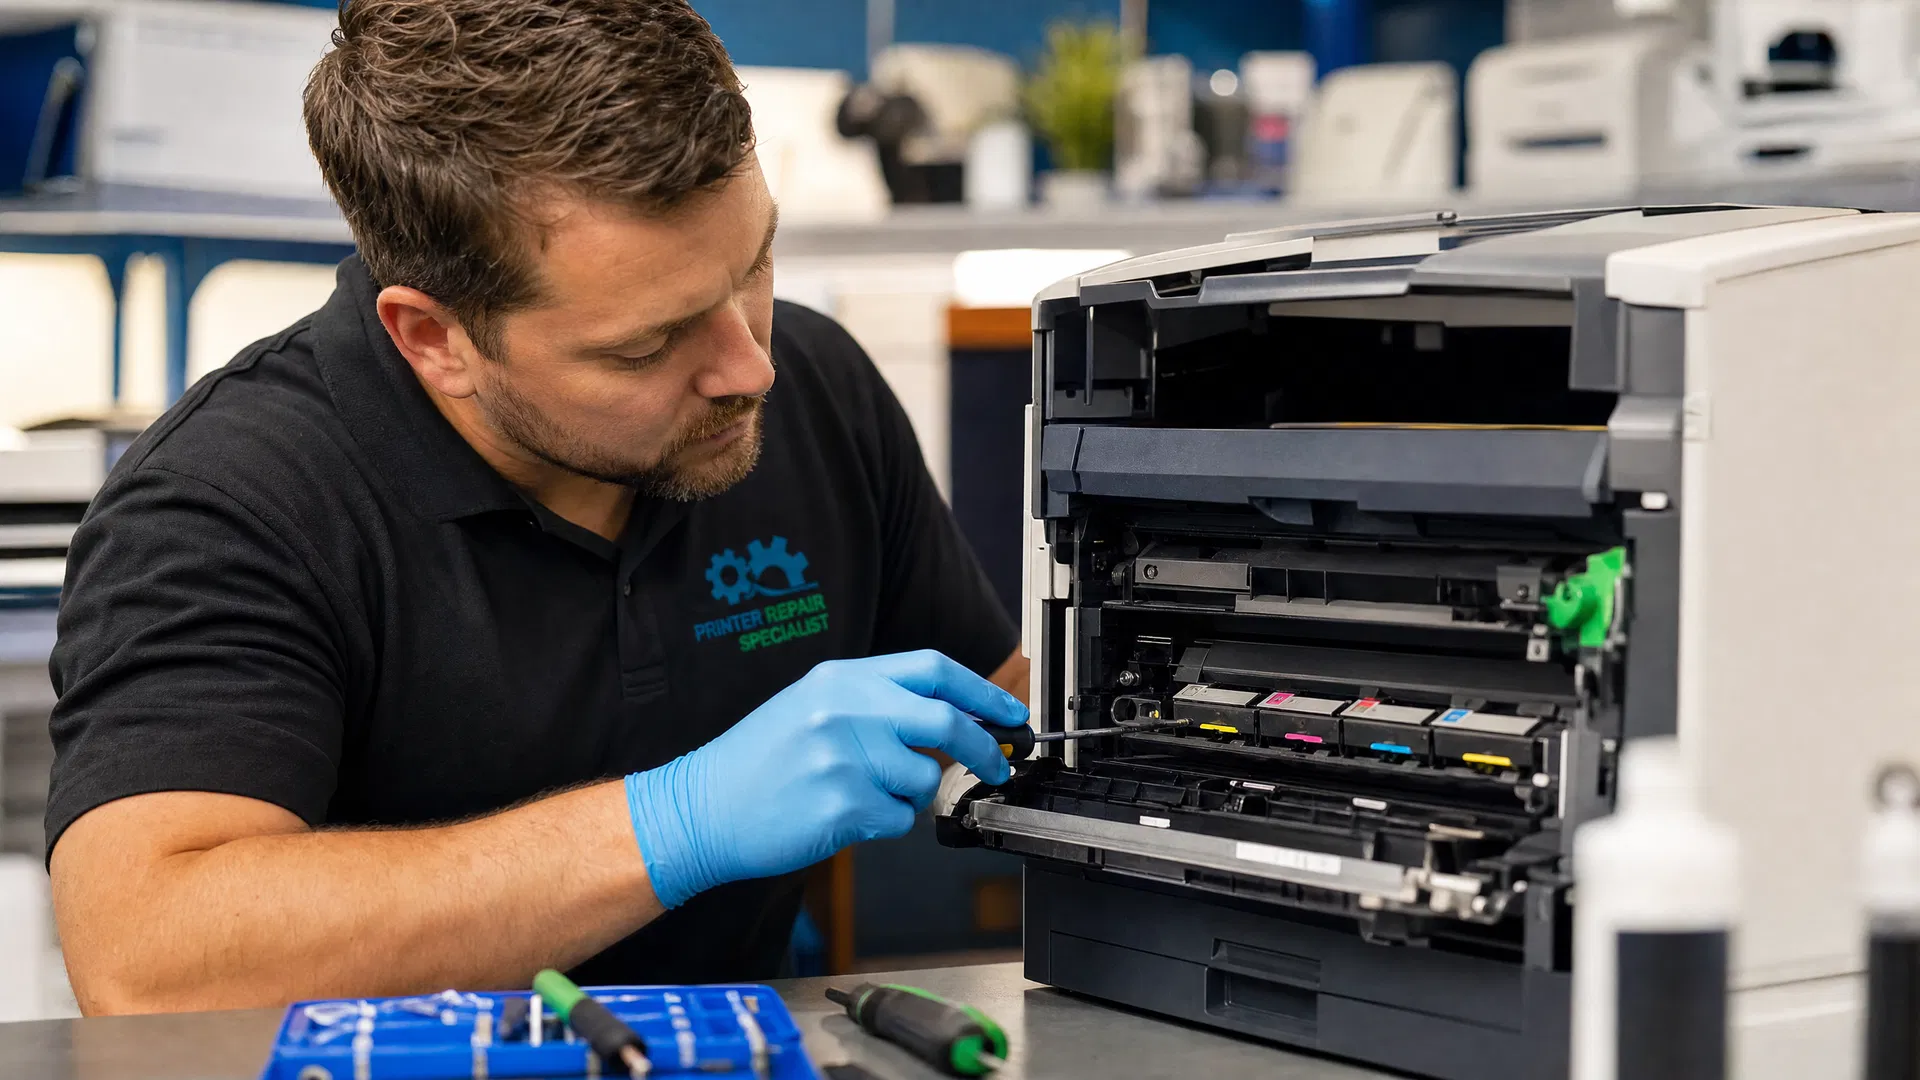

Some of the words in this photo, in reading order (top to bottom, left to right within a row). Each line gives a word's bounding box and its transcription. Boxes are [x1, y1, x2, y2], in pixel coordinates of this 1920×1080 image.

[694, 609, 763, 641] PRINTER
[764, 594, 826, 623] REPAIR
[738, 613, 829, 652] SPECIALIST
